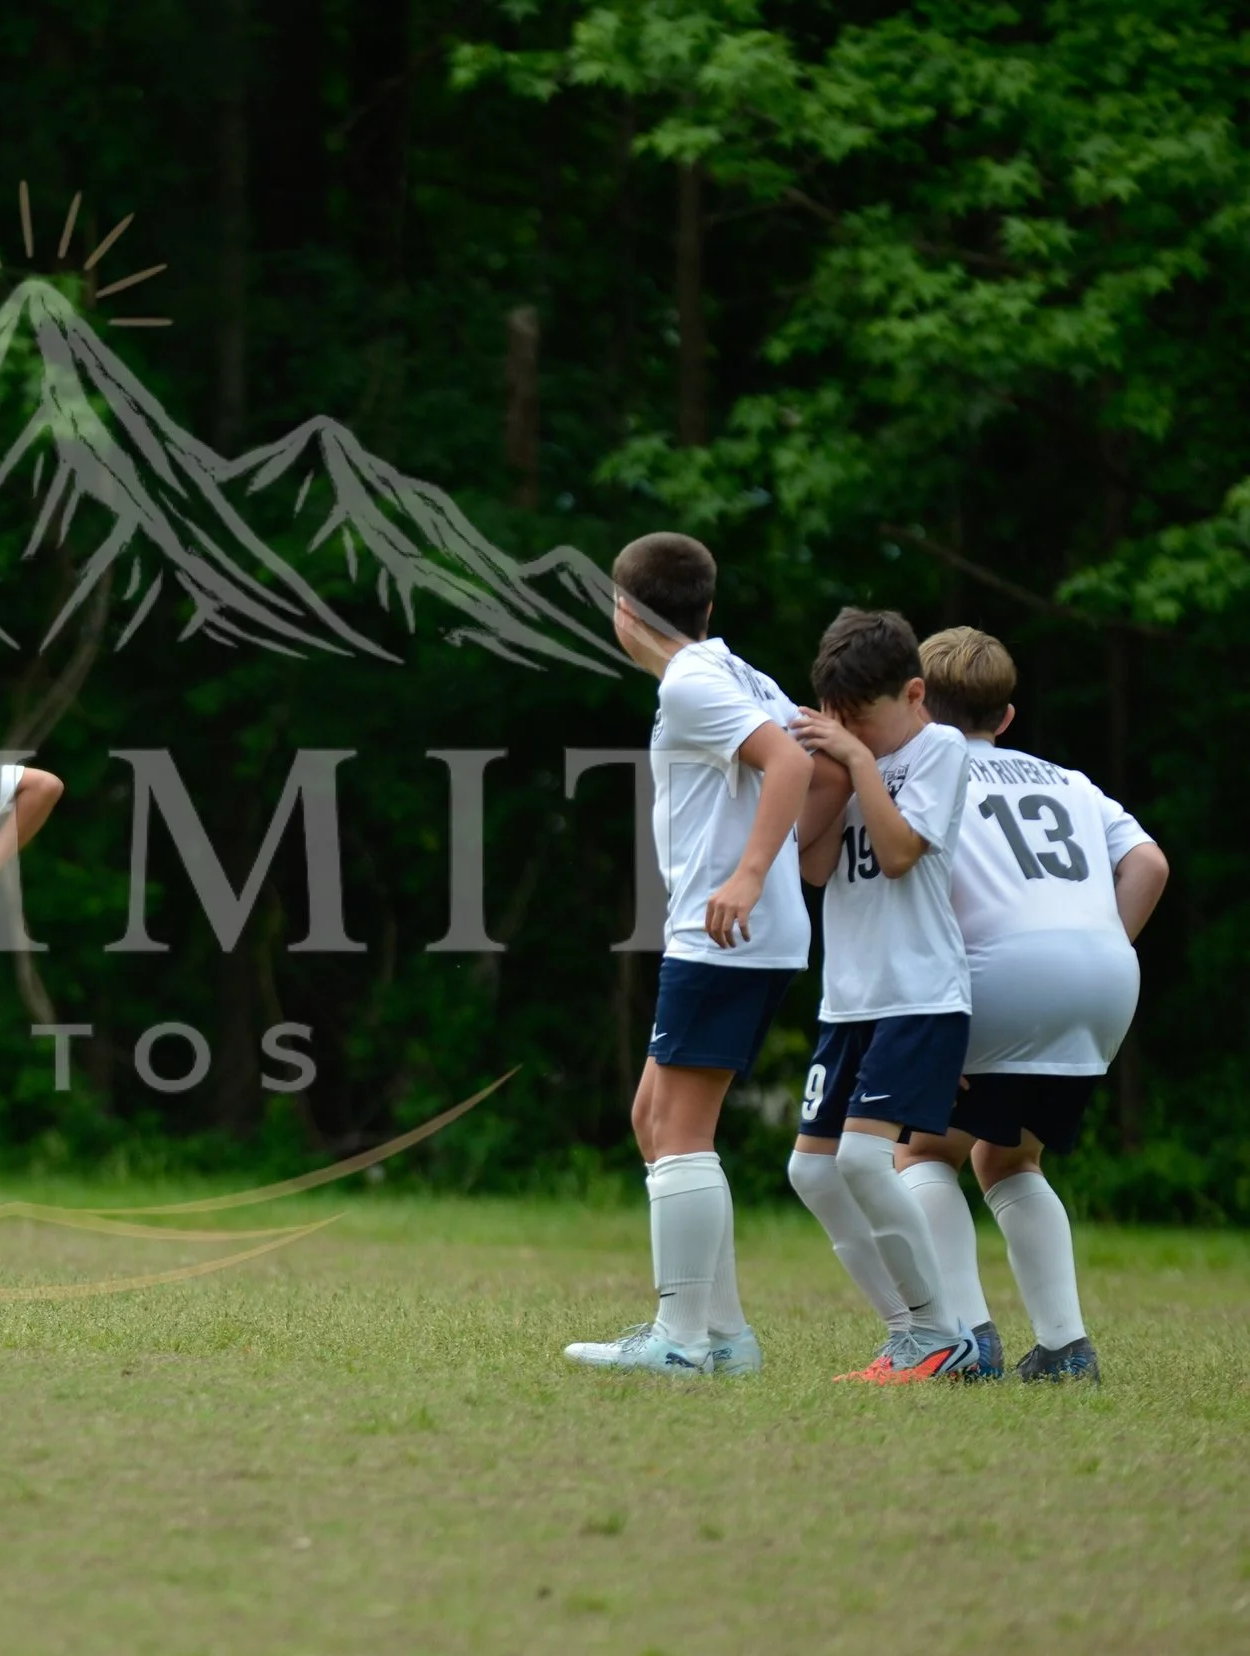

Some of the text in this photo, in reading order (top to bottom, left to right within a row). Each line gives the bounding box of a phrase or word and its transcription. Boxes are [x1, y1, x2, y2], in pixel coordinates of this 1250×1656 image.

[989, 758, 1051, 785] RIVER
[1037, 760, 1070, 786] FC
[842, 825, 881, 883] 19
[978, 793, 1090, 882] 13
[801, 1063, 827, 1121] 9
